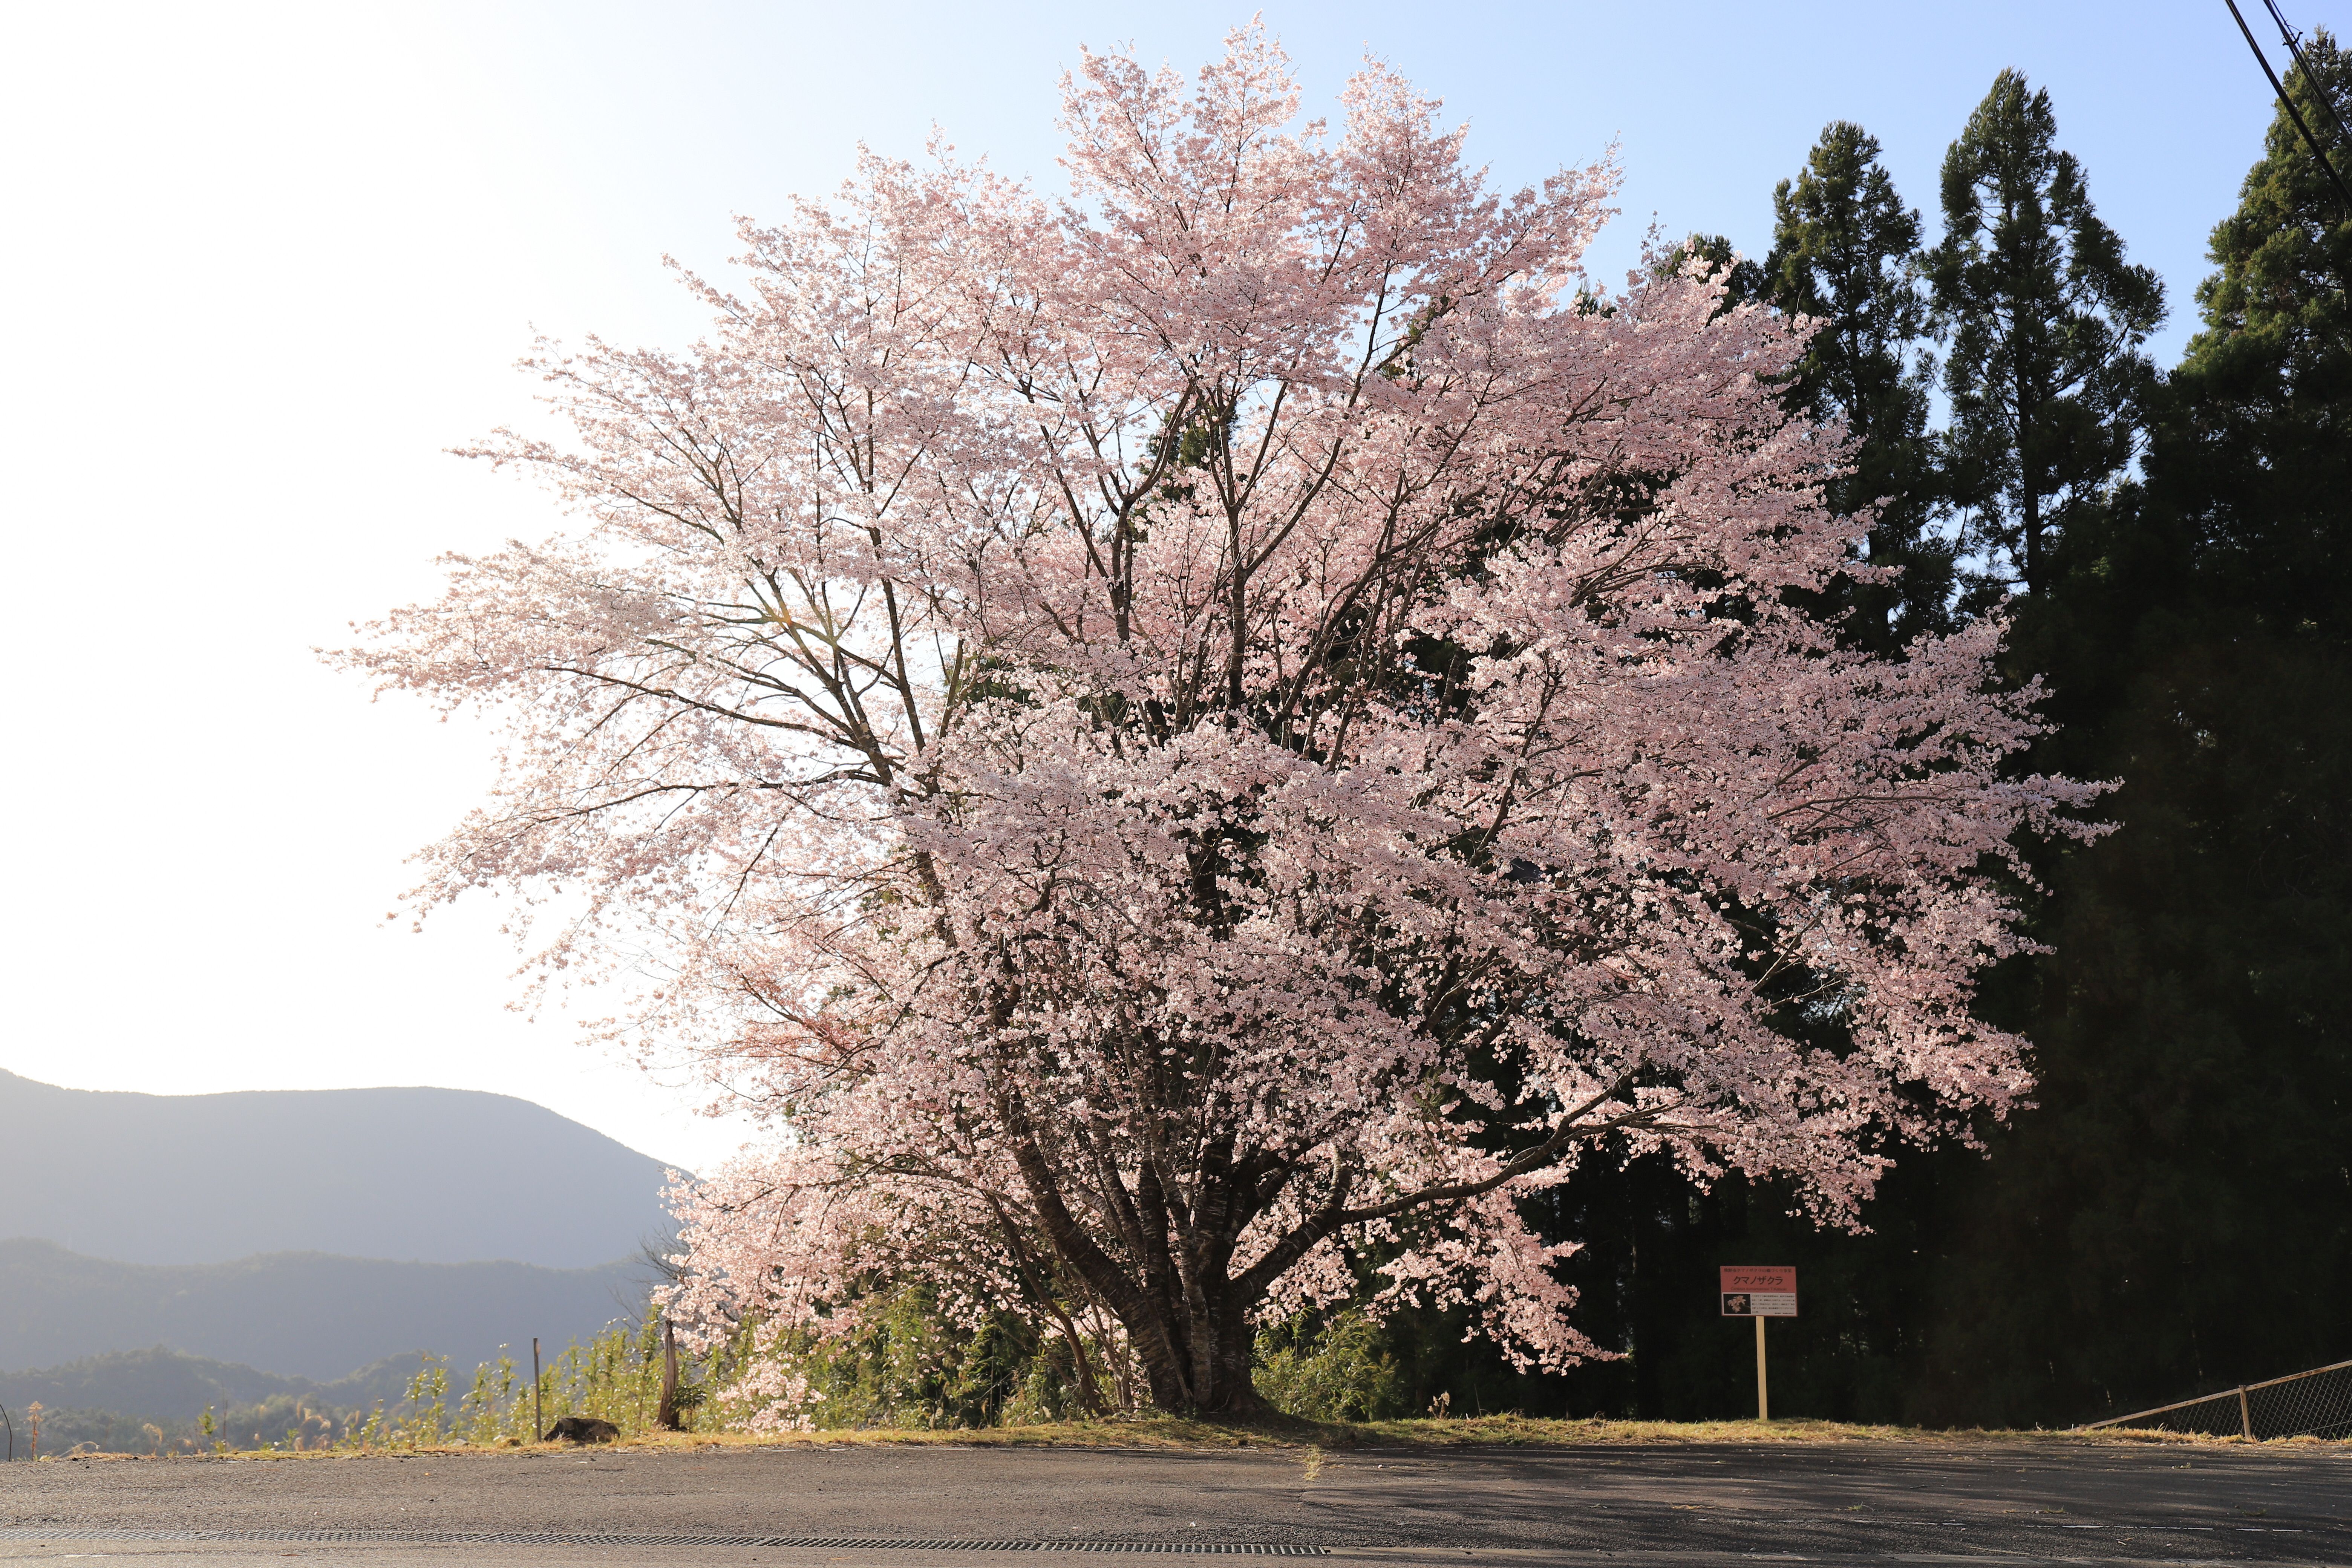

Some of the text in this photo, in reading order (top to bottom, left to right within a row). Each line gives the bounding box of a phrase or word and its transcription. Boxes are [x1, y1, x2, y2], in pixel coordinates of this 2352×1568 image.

[1733, 1276, 1783, 1285] クマノザクラ
